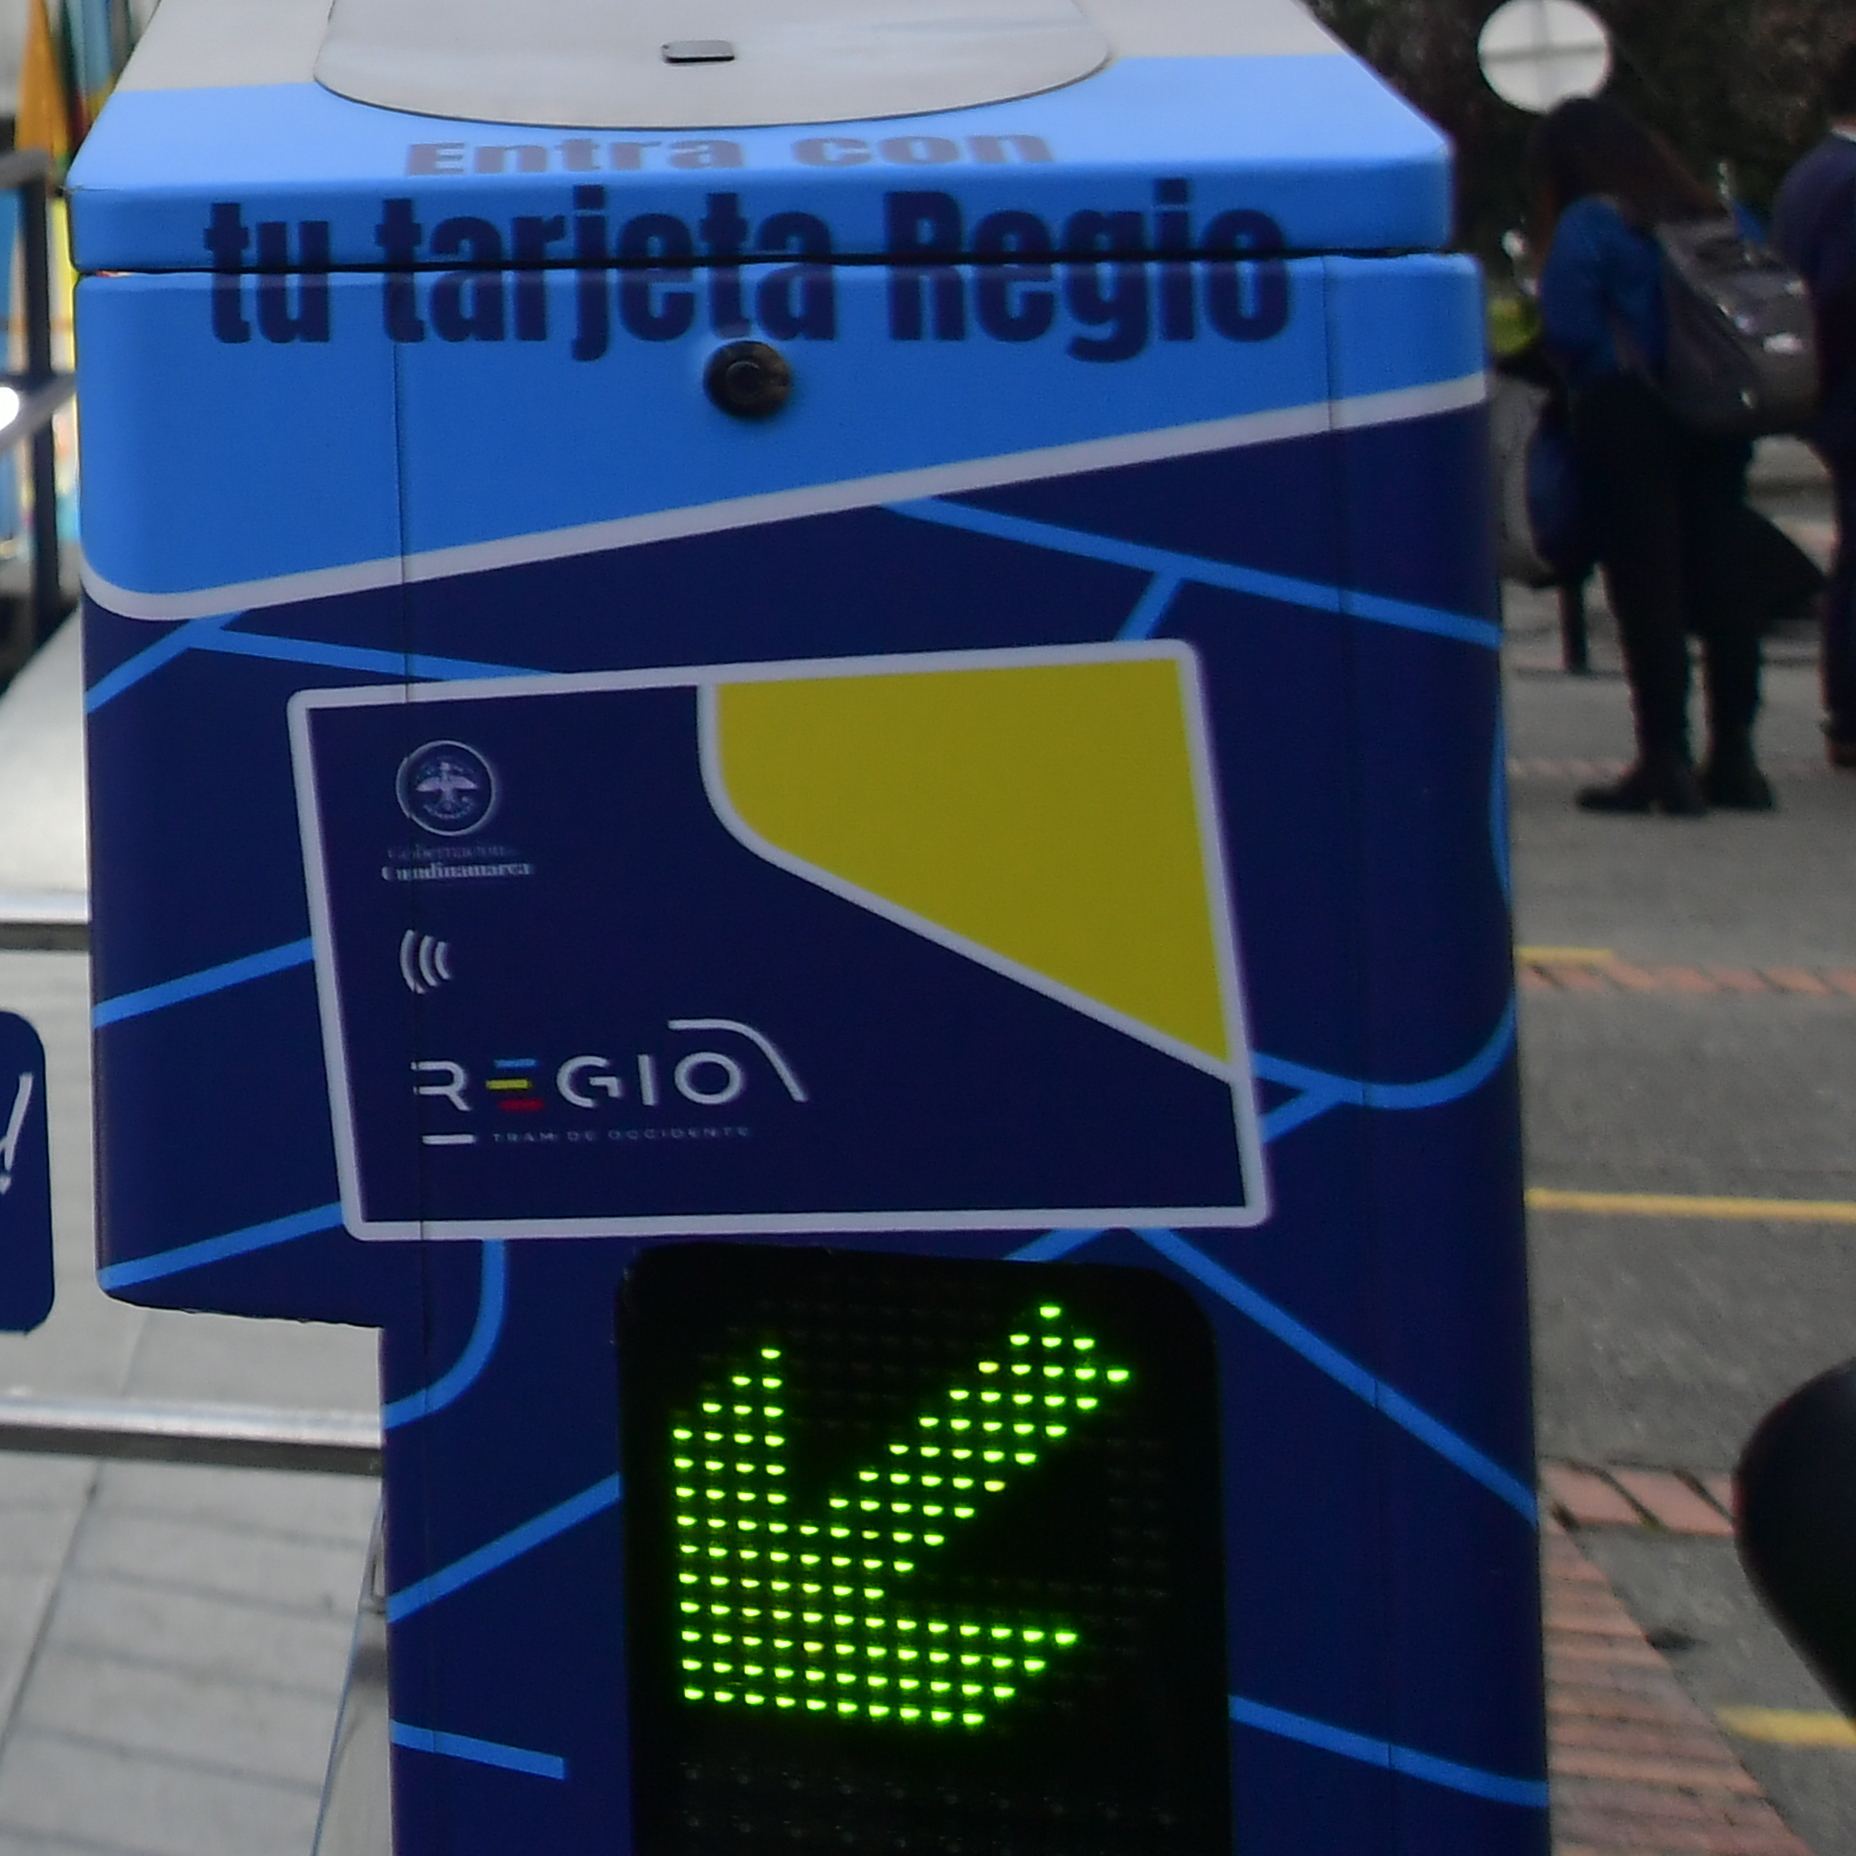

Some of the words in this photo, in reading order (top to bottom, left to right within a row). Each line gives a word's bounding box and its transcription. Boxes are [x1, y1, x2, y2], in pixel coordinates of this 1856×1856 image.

[405, 137, 743, 175] Entra
[792, 134, 1054, 166] con
[204, 201, 330, 343] tu
[376, 184, 837, 361] tarjeta
[884, 178, 1289, 362] Regio
[410, 1050, 745, 1112] REGIO
